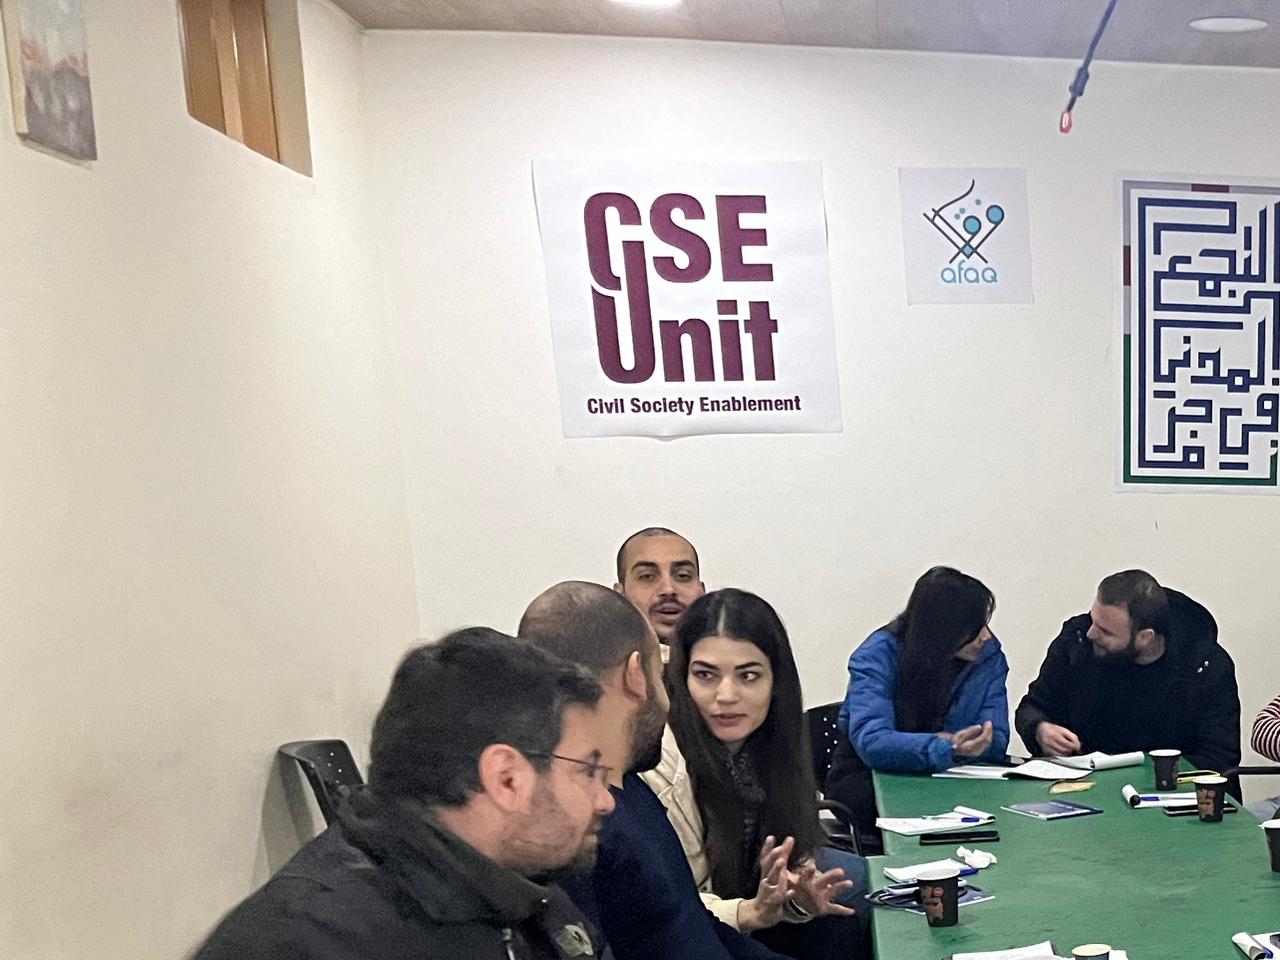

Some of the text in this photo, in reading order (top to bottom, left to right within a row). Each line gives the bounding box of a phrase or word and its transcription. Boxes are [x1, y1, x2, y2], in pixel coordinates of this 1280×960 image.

[591, 241, 778, 384] Unit
[587, 395, 801, 416] Civil Society Enablement
